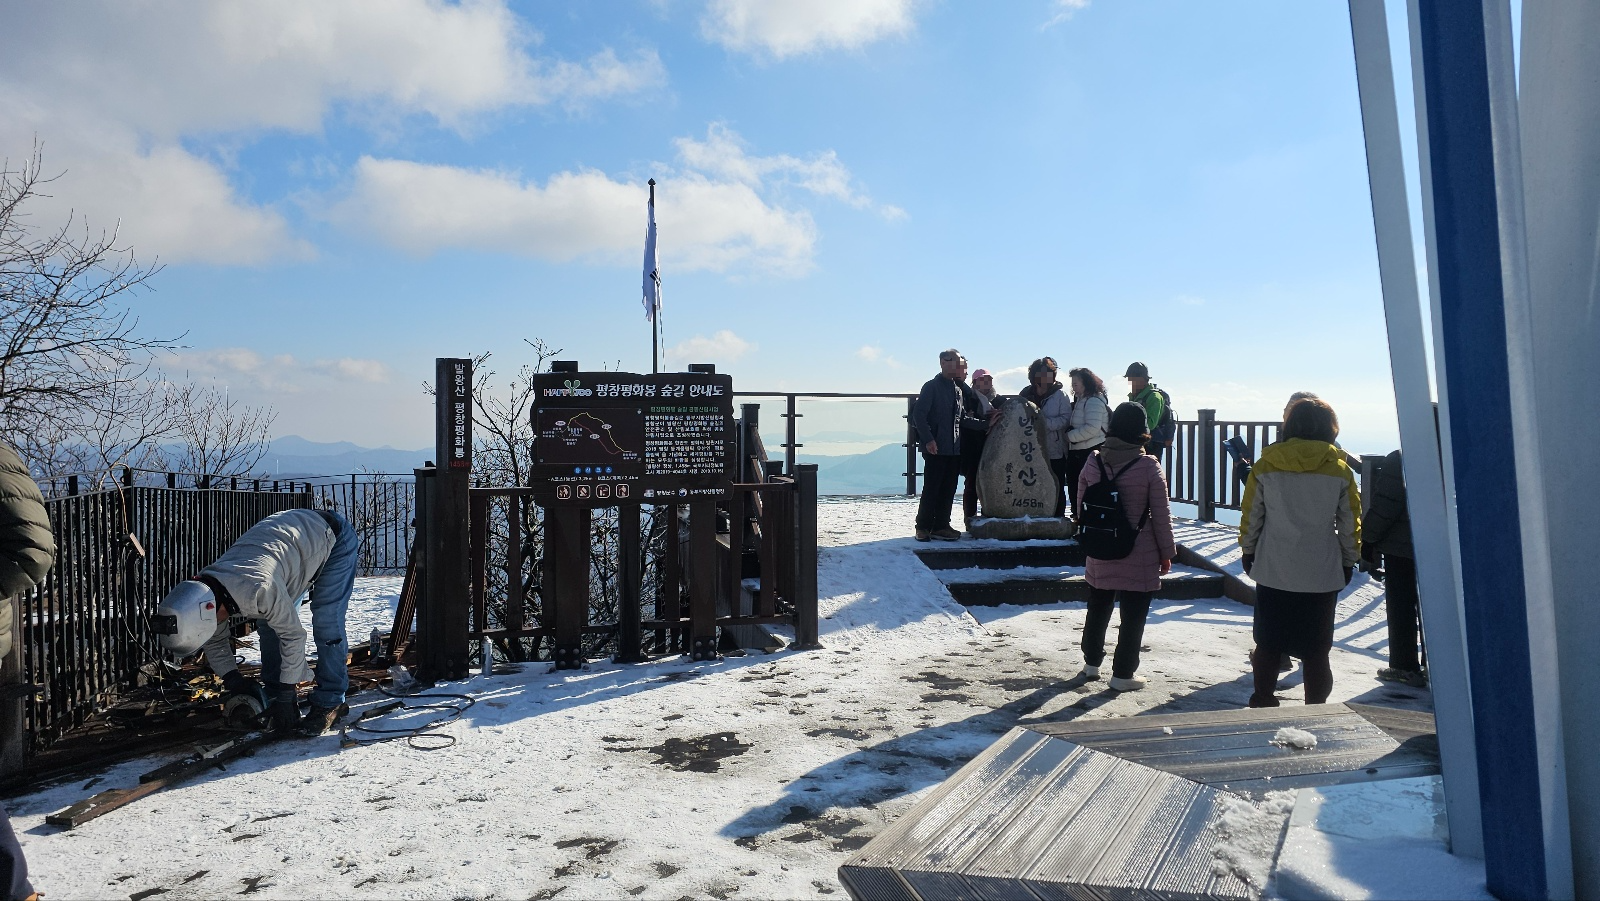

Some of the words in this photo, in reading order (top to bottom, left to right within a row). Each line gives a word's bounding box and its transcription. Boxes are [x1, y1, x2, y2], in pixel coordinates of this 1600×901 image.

[454, 363, 465, 397] 발왕산
[596, 383, 656, 397] 평창평화봉
[660, 384, 685, 397] 숲길
[689, 384, 724, 396] 안내도
[454, 402, 465, 458] 평창평화봉
[1018, 415, 1038, 487] 발왕산
[1012, 498, 1044, 509] 1458m
